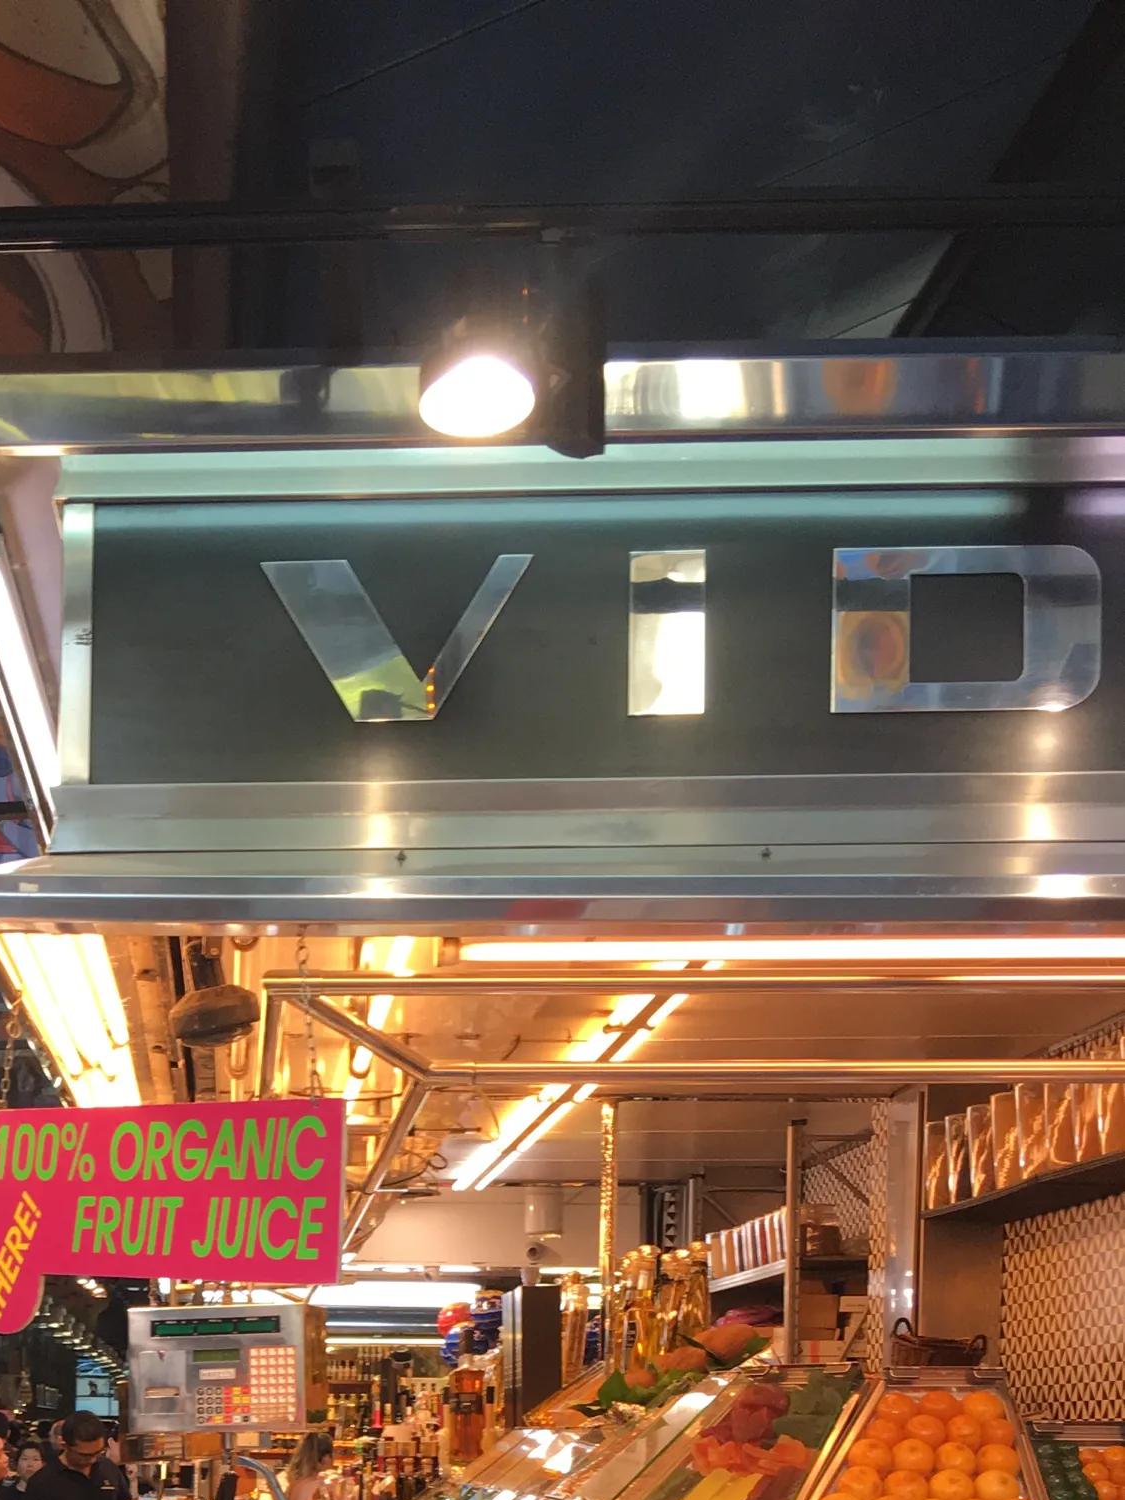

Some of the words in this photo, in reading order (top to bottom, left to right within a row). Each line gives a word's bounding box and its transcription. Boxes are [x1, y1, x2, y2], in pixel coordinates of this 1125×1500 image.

[109, 1115, 327, 1181] ORGANIC
[71, 1195, 184, 1256] FRUIT
[191, 1196, 326, 1260] JUICE
